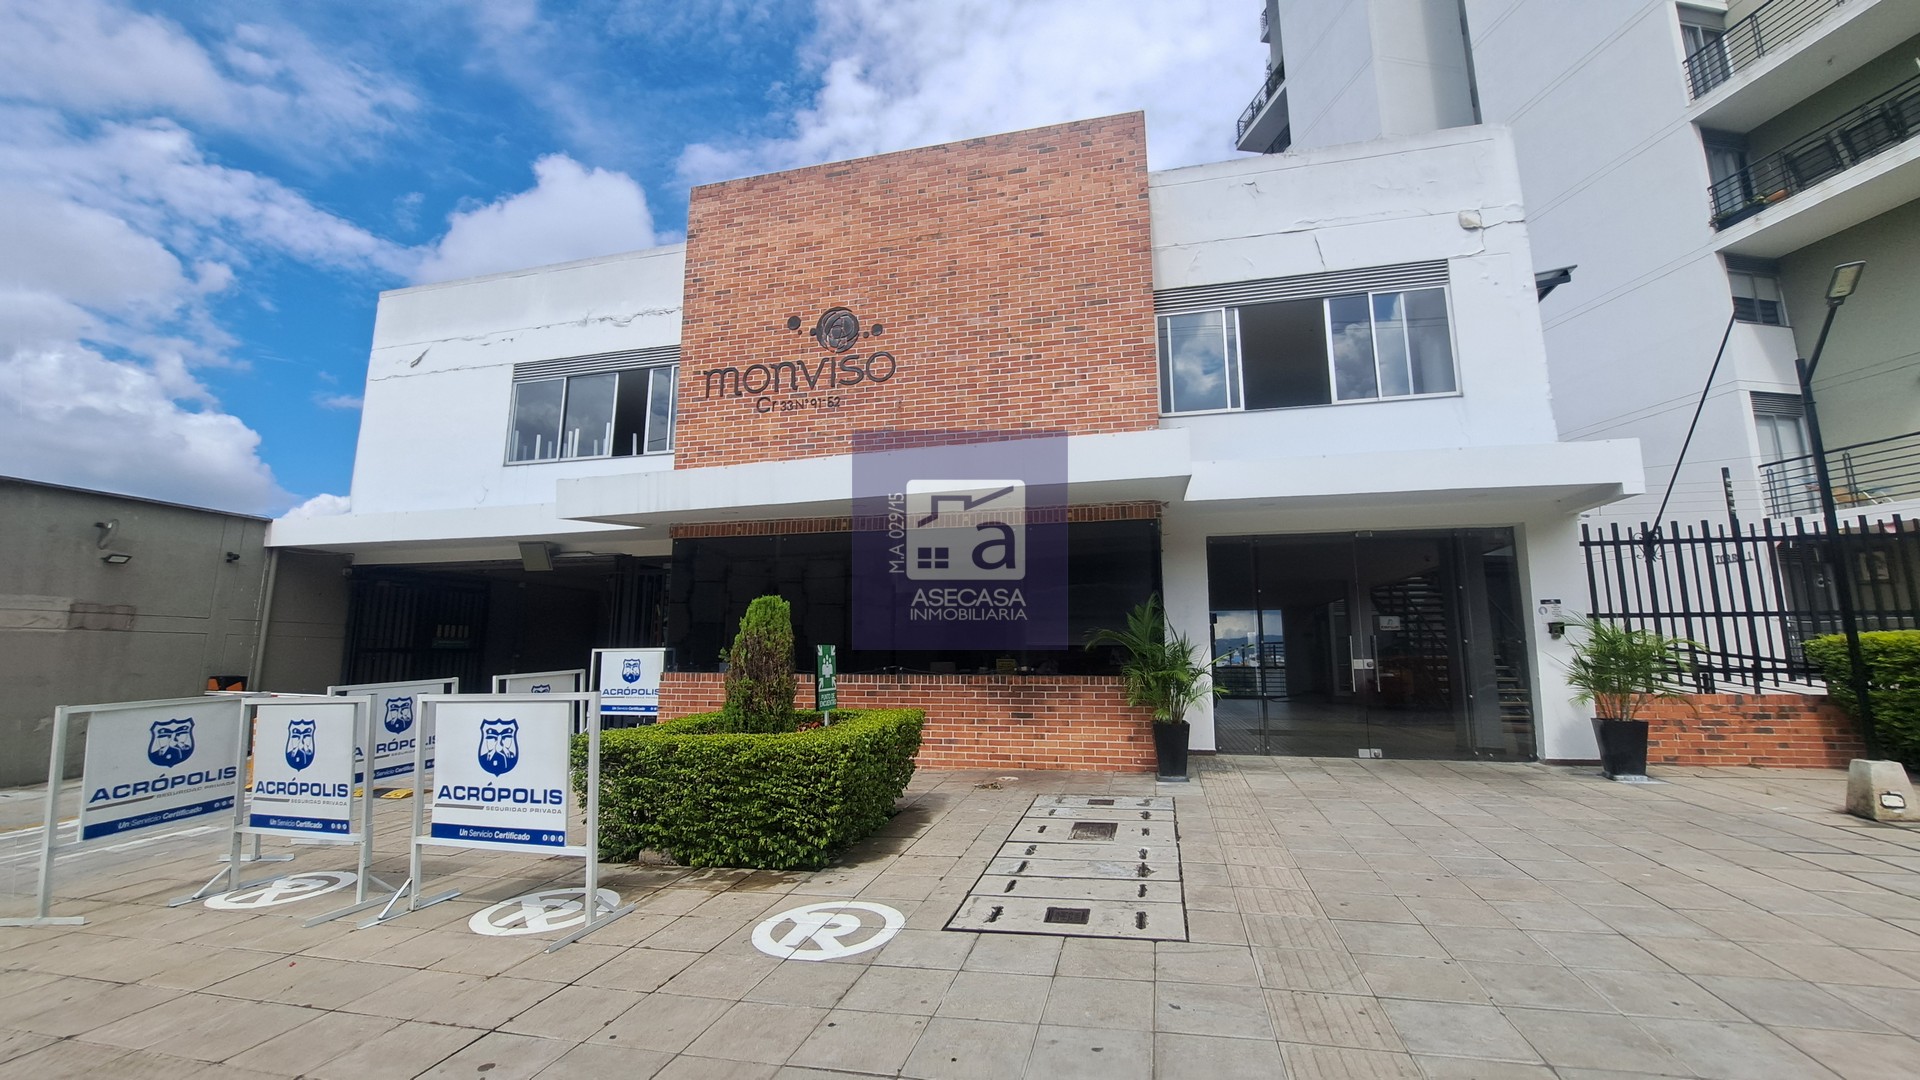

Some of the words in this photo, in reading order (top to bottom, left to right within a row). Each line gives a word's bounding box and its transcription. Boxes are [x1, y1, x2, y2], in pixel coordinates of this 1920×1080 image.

[756, 396, 778, 413] Cr
[89, 766, 237, 804] ACRÓPOLIS
[255, 777, 348, 798] ACRÓPOLIS
[437, 781, 563, 805] ACRÓPOLIS
[485, 805, 528, 813] SEGURIDAD
[529, 807, 562, 815] PRIVADA
[459, 828, 468, 836] Un
[468, 830, 493, 839] Servicio
[493, 832, 531, 842] Certificado
